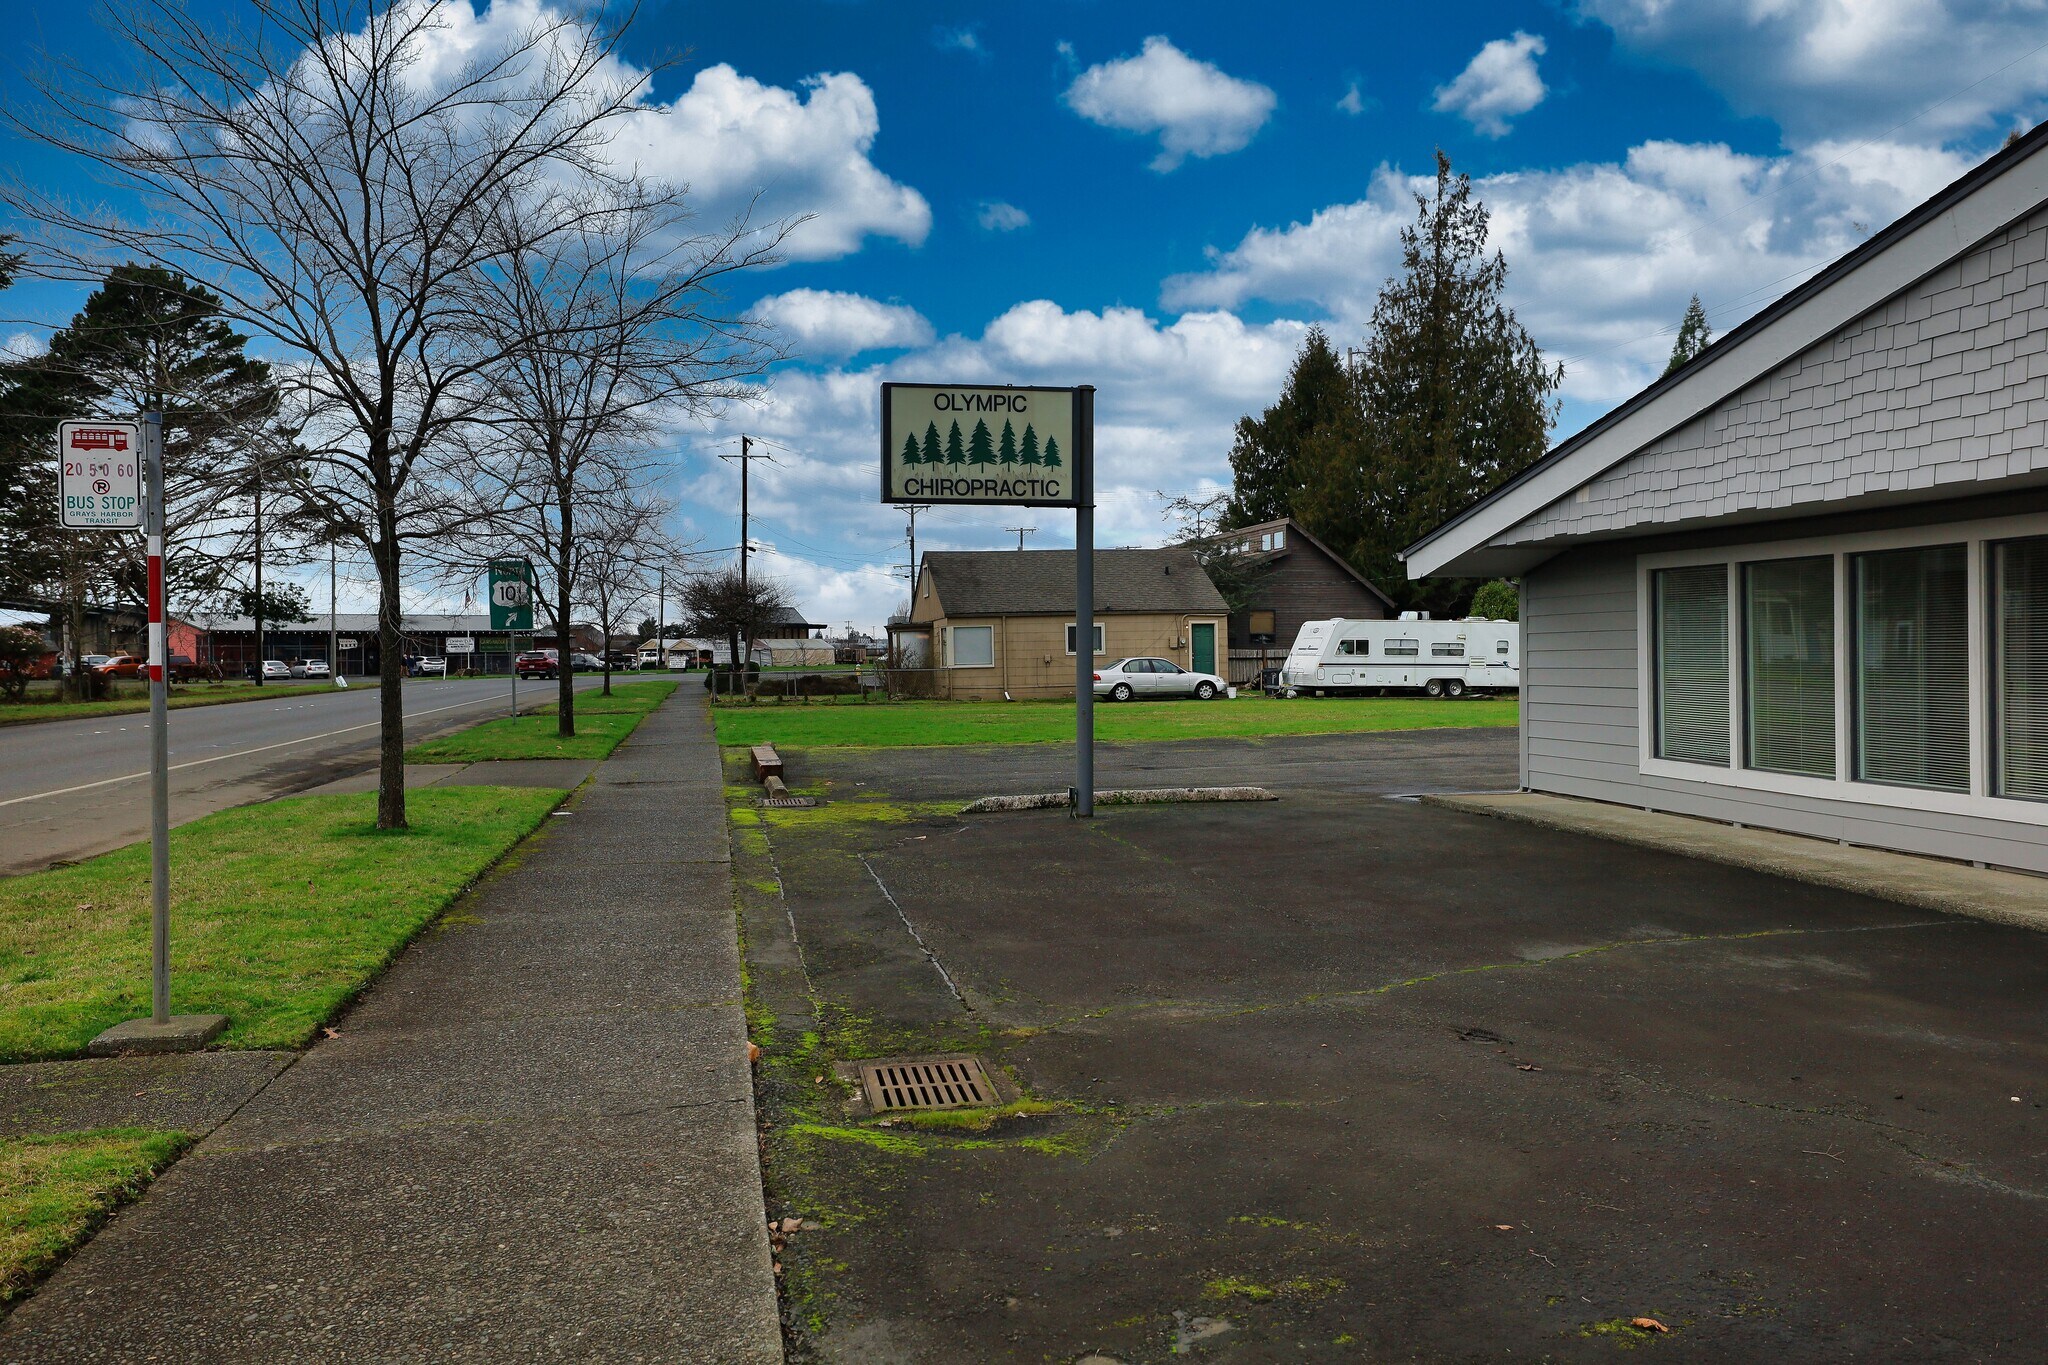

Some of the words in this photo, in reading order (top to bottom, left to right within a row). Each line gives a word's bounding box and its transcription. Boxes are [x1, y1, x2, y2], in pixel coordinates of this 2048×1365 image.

[934, 393, 1027, 413] OLYMPIC
[65, 462, 82, 476] 20
[117, 464, 133, 477] 60
[904, 478, 1060, 497] CHIROPRACTIC
[67, 495, 94, 509] BUS
[101, 496, 135, 510] STOP
